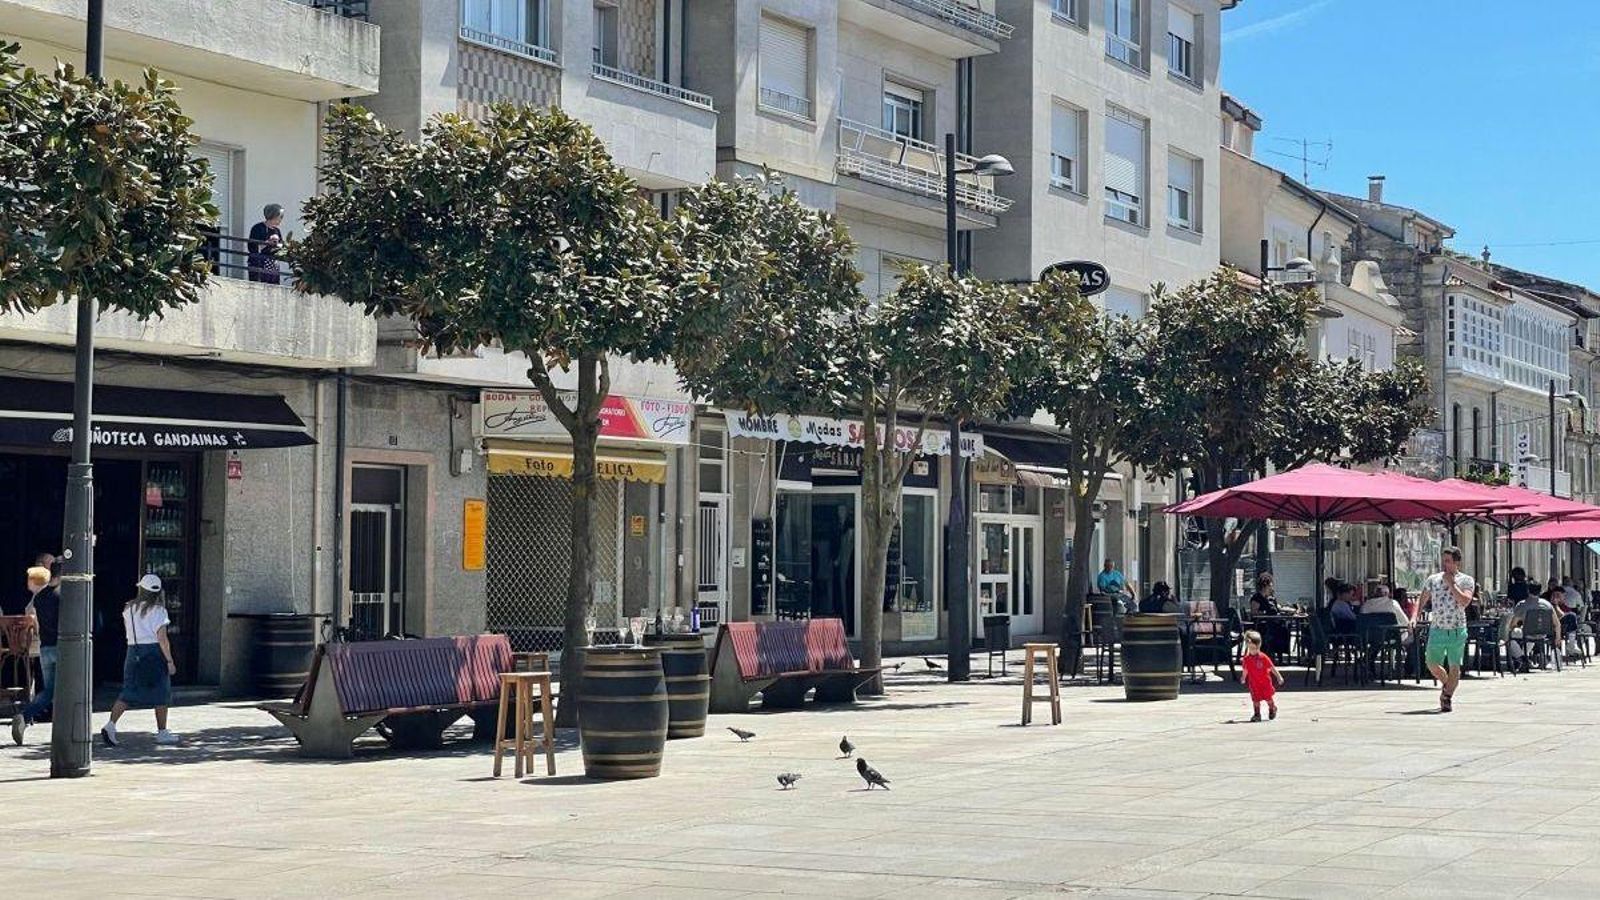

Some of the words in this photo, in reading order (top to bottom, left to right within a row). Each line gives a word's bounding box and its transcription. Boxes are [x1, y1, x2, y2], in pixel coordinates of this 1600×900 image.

[641, 401, 661, 412] FOTO
[738, 417, 778, 434] HOMBRE
[806, 421, 842, 441] Modas
[153, 431, 229, 447] GANDAINAS
[525, 458, 554, 472] Foto
